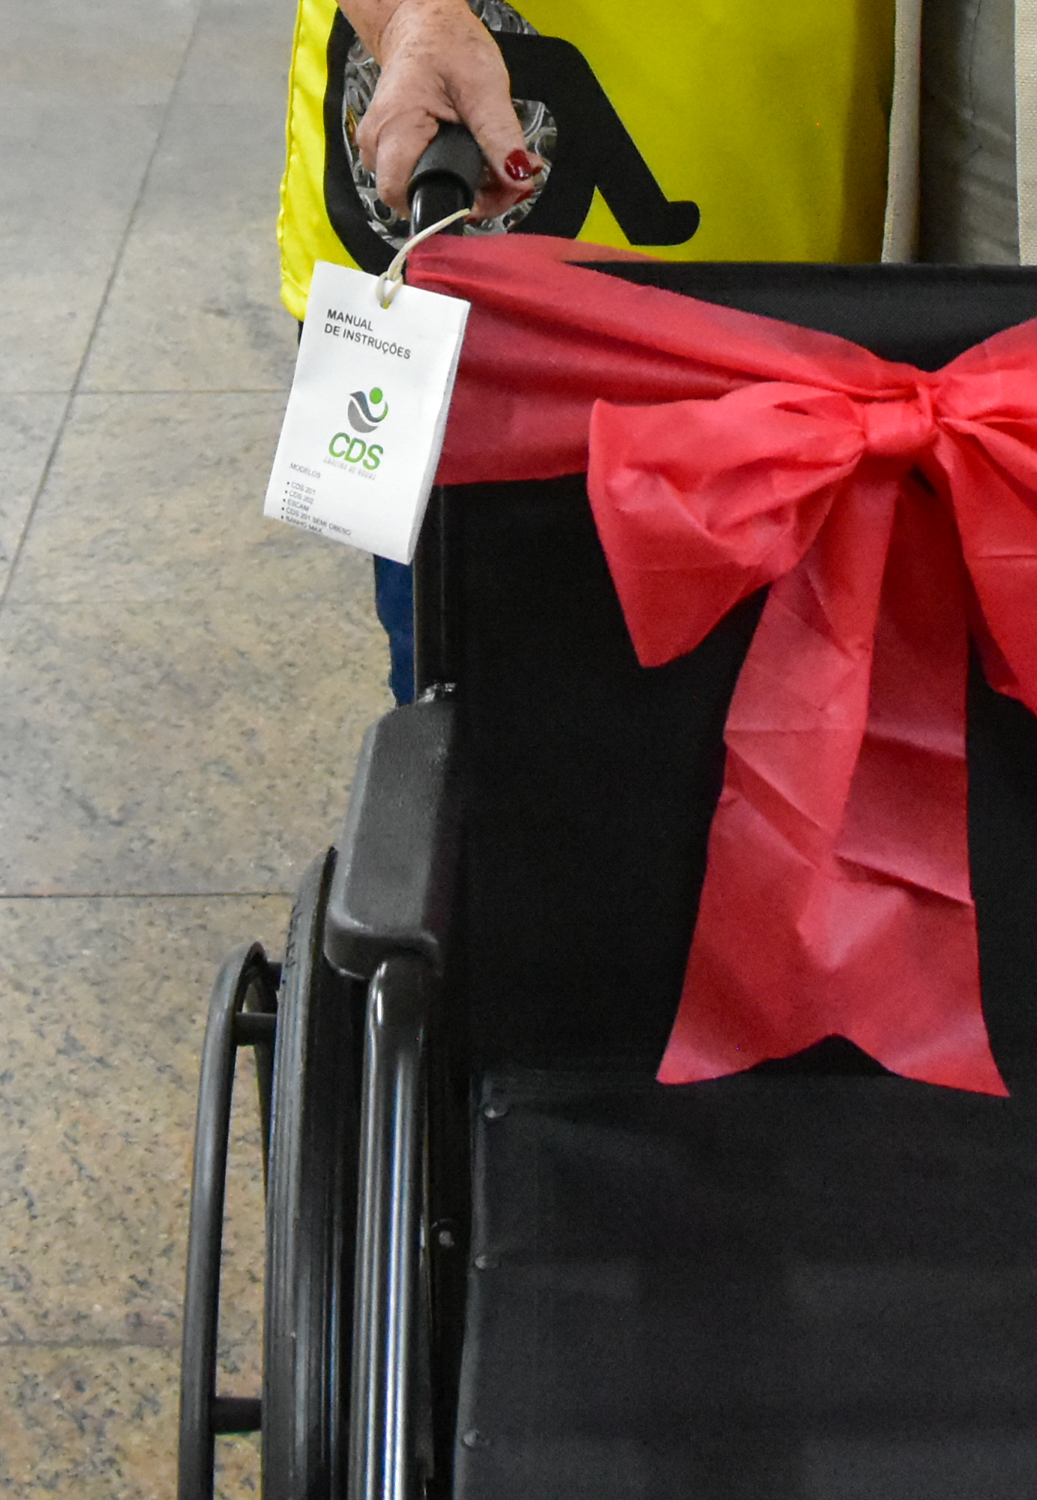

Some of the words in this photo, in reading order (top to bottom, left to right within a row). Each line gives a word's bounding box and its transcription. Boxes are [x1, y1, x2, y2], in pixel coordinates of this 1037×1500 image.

[326, 308, 374, 332] MANUAL
[324, 323, 341, 337] DE
[342, 329, 411, 360] INSTRUÇÕES
[328, 432, 384, 470] CDS
[290, 462, 321, 479] MODELOS
